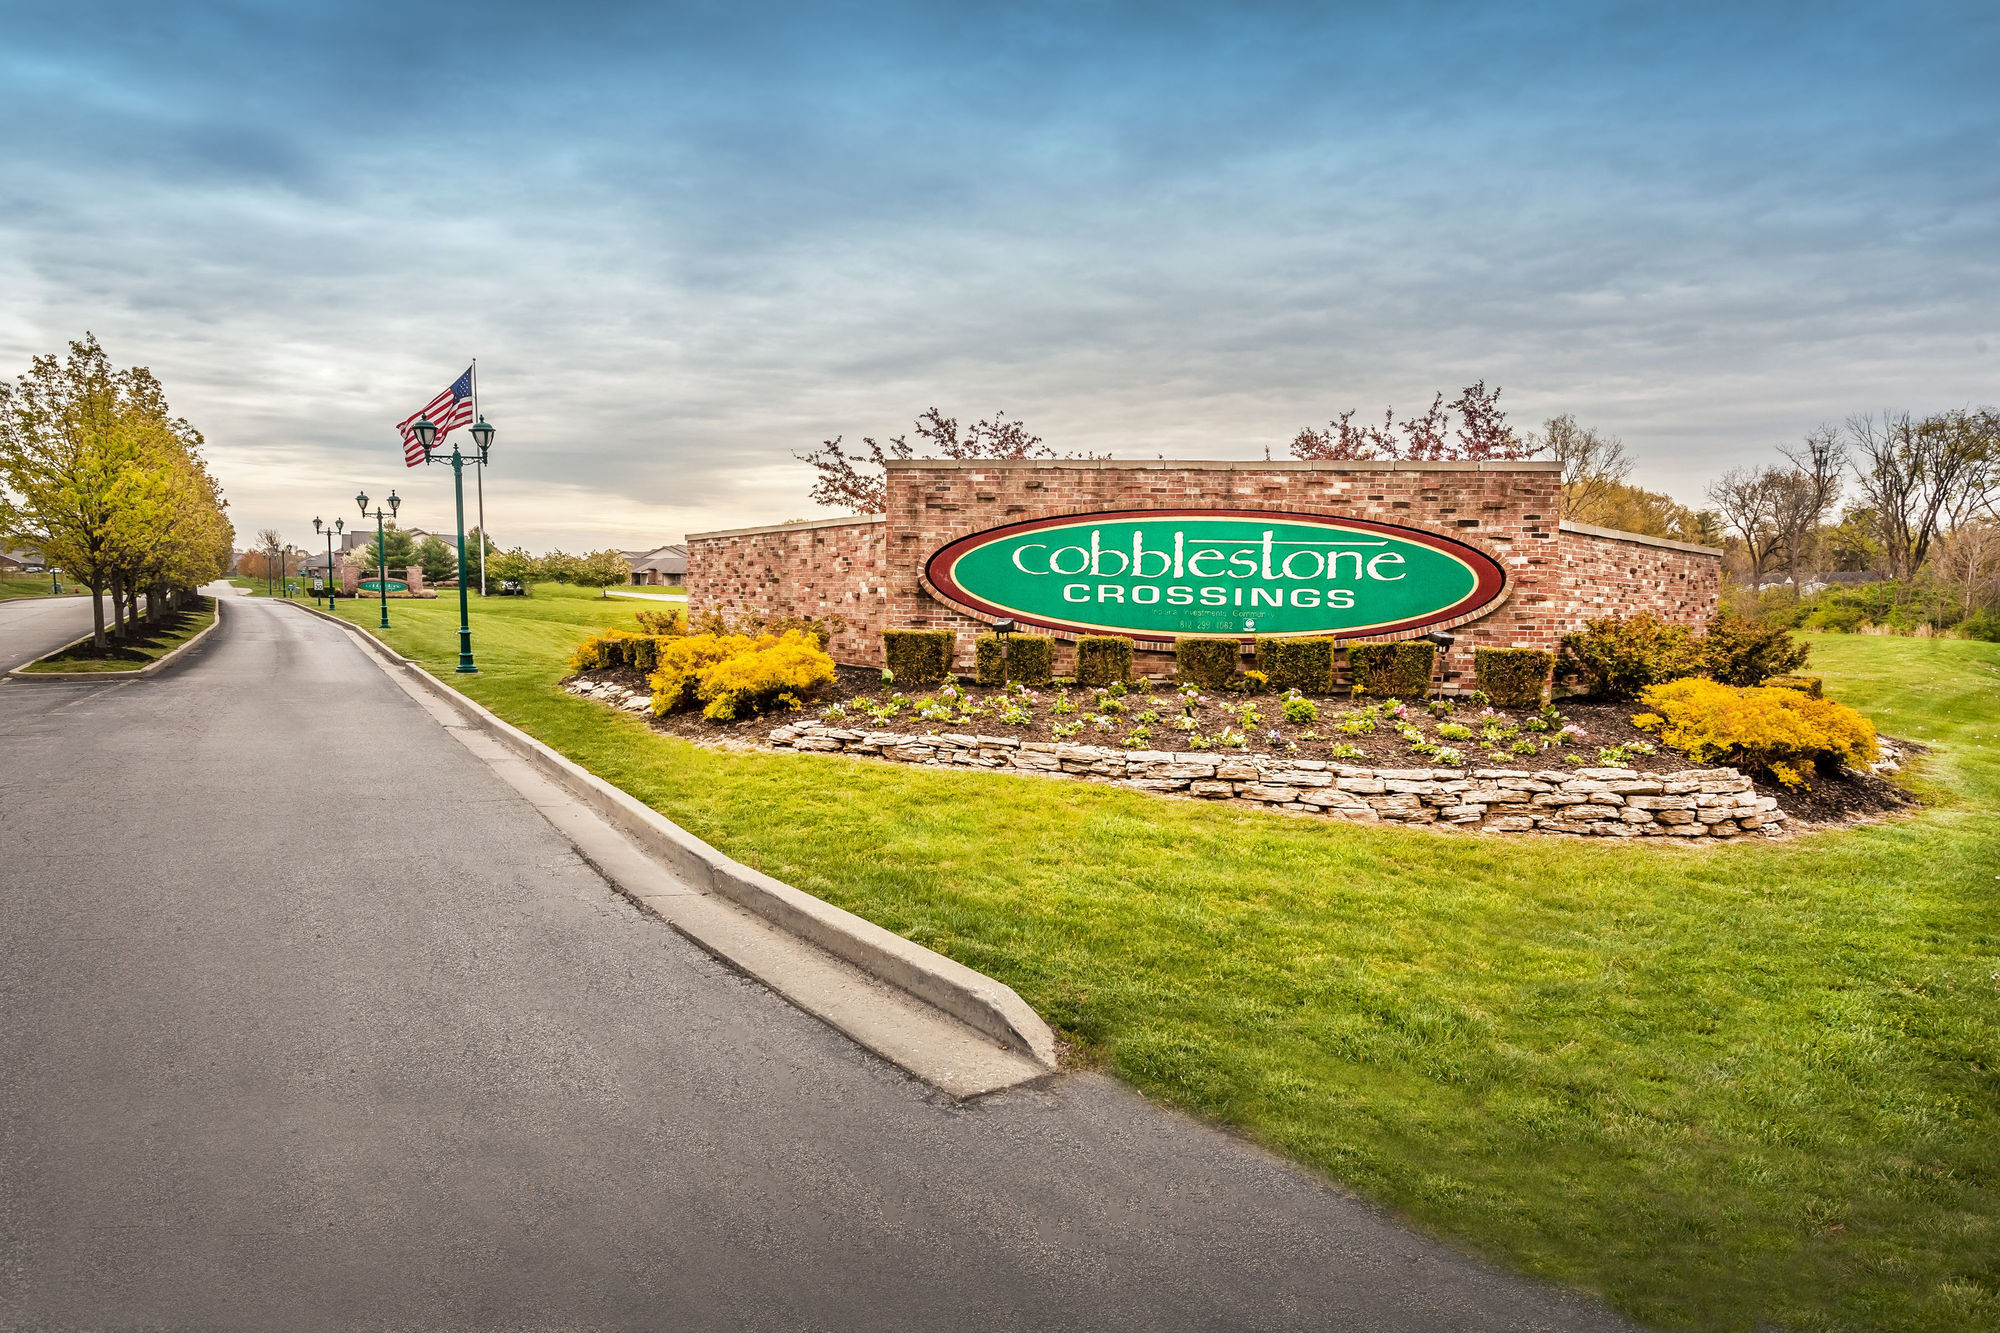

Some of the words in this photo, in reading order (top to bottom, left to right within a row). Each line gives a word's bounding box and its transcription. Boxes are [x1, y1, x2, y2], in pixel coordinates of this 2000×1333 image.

[1063, 583, 1355, 609] CROSSINGS
[1184, 608, 1228, 618] nvestments
[1232, 609, 1275, 620] Communy
